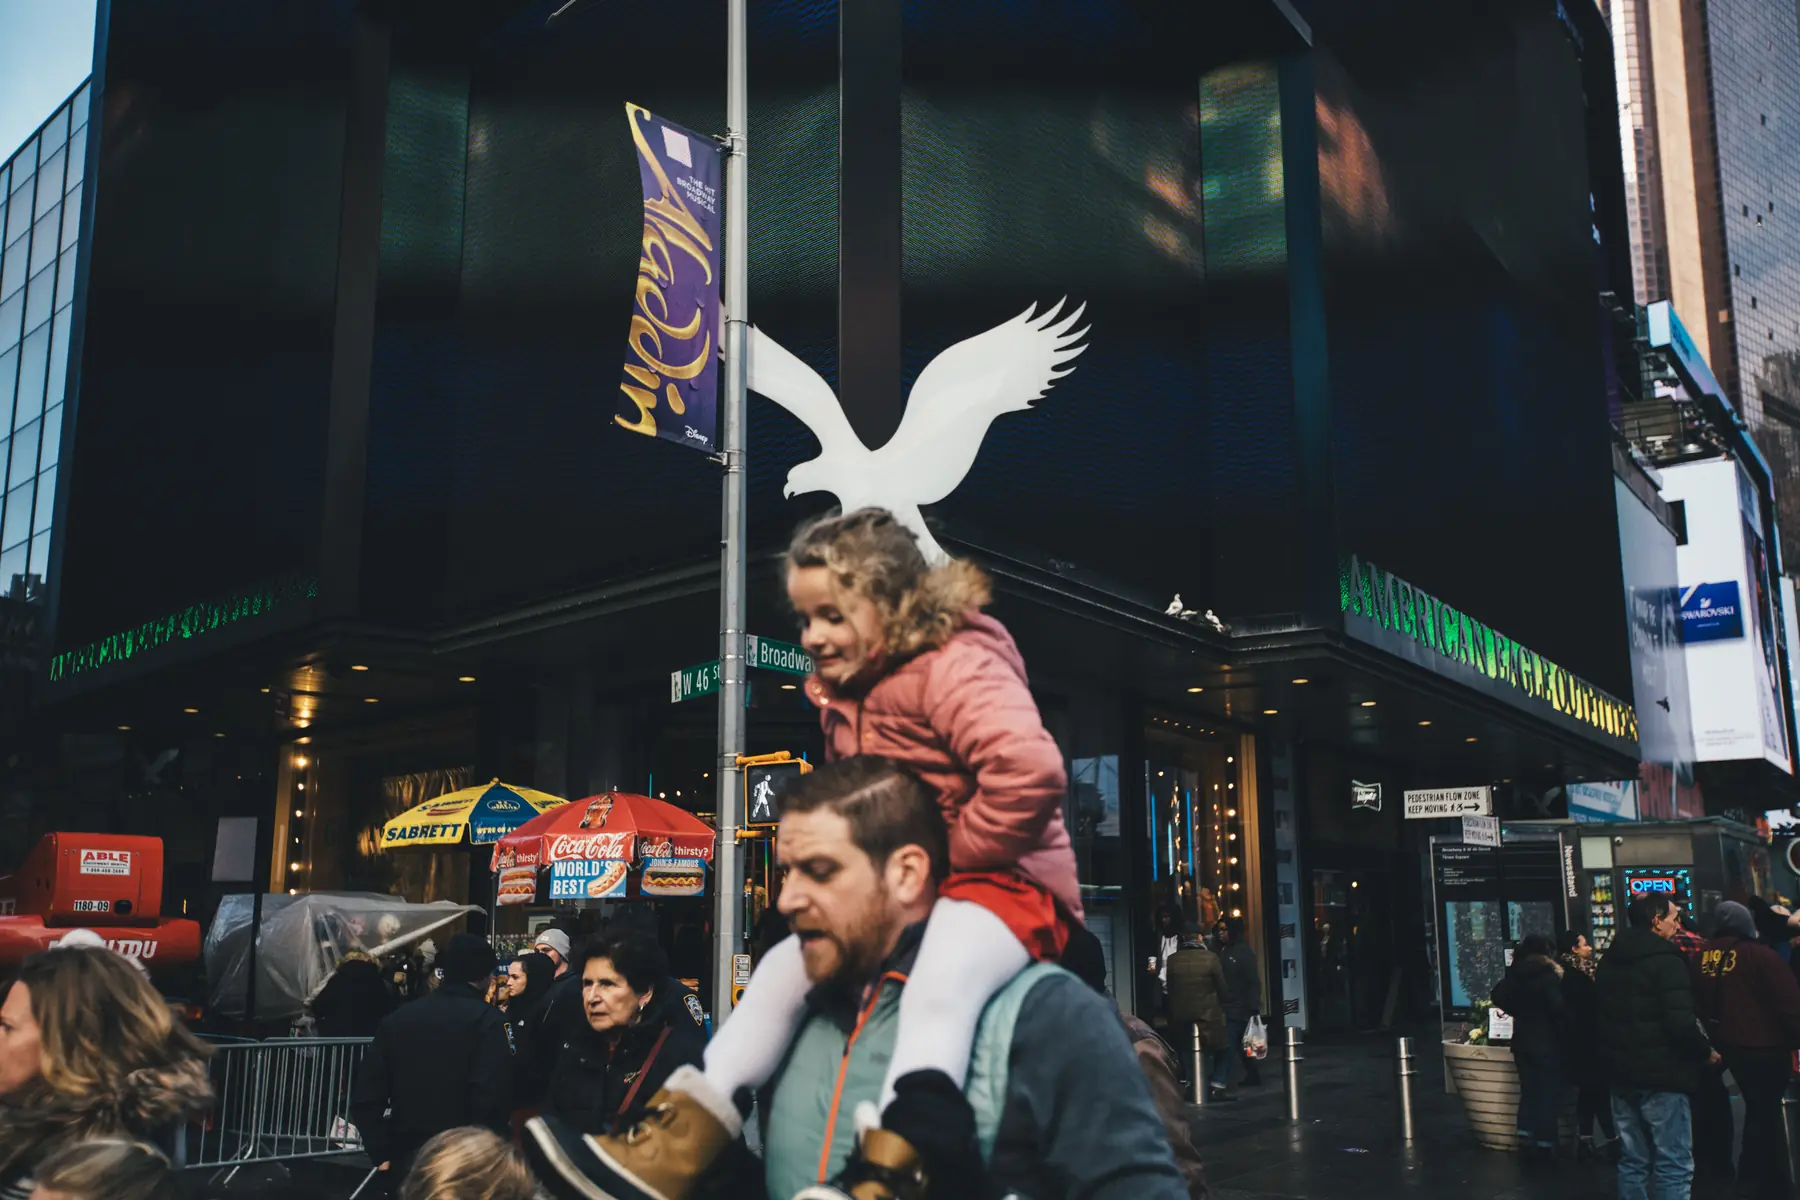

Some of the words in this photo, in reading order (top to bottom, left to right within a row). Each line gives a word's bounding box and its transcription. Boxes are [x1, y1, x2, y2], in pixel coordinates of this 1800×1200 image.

[689, 176, 704, 189] THE
[677, 177, 715, 204] BROADWAY
[687, 191, 715, 214] MUSICAL
[685, 425, 708, 445] Disney
[1348, 553, 1489, 677] AMERICAN
[1682, 605, 1735, 620] SWAROVSKI
[683, 673, 692, 695] W
[696, 668, 709, 691] 46
[1408, 793, 1445, 803] PEDESTRIAN
[1446, 791, 1462, 800] FLOW
[1464, 790, 1480, 800] ZONE
[1408, 804, 1423, 814] KEEP
[1424, 803, 1447, 813] MOVING
[386, 824, 461, 842] SABRETT
[83, 852, 128, 864] ABLE
[674, 846, 709, 857] thirsty?
[554, 861, 613, 877] WORLD'S
[649, 858, 672, 867] JOHN'S
[674, 858, 699, 867] FAMOUS
[1564, 845, 1578, 897] Newsstand
[553, 879, 586, 895] BEST
[1631, 879, 1674, 892] OPEN
[74, 901, 109, 911] 1180-09
